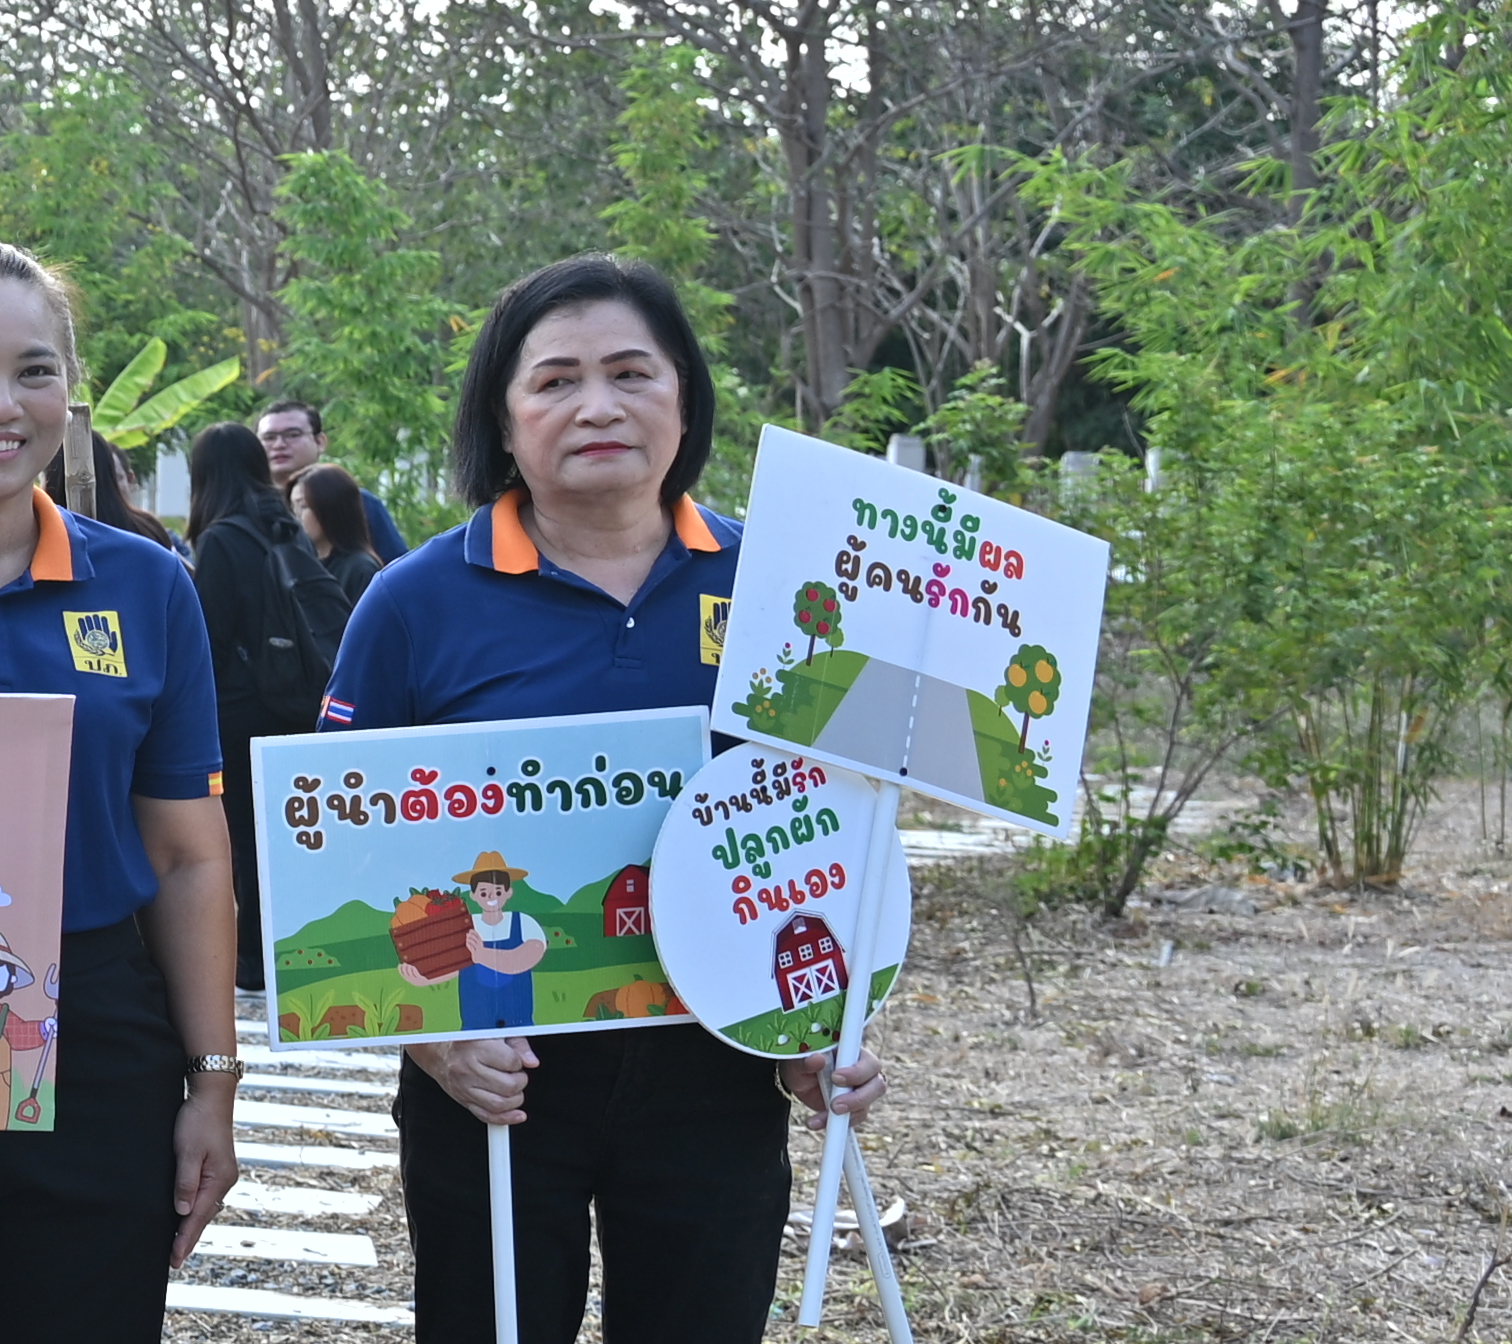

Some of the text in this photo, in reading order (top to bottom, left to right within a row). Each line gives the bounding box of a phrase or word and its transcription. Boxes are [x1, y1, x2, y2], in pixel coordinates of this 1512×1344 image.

[852, 487, 1024, 580] ทางนี้มีผล
[835, 534, 1022, 638] ผู้คนรักกัน
[285, 754, 683, 850] ผู้นำต้องทำก่อน
[692, 757, 827, 826] บ้านนี้มีรัก
[712, 795, 840, 879] ปลูกผัก
[731, 863, 846, 925] กินเอง
